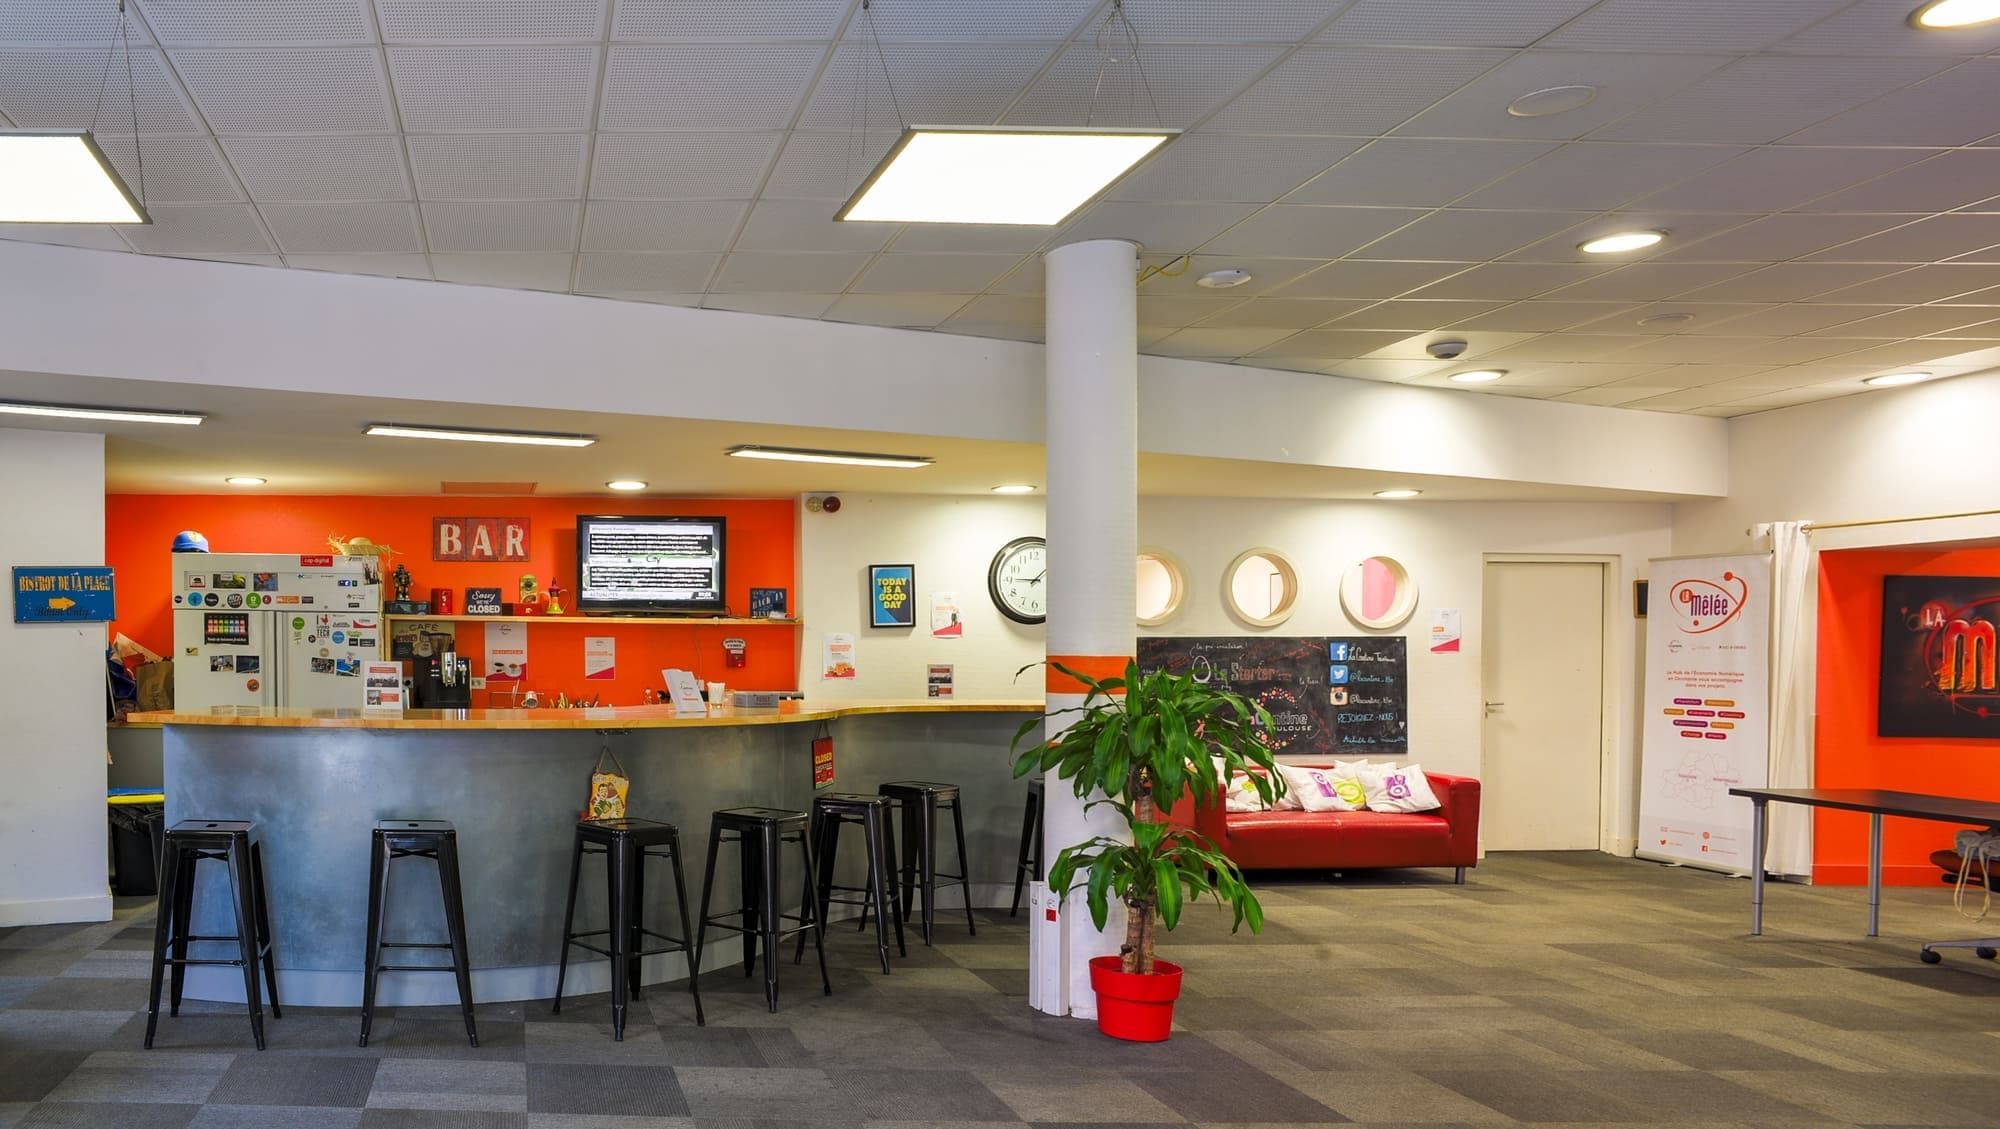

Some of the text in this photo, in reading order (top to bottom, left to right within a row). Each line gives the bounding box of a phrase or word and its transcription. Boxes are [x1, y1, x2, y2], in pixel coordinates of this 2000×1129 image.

[440, 524, 525, 556] BAR
[1020, 555, 1026, 564] 11
[1030, 551, 1039, 560] 12
[1011, 565, 1020, 574] 10
[19, 576, 111, 592] BISTROT DE LA PLAGE
[877, 577, 907, 586] TODAY
[1006, 576, 1012, 584] 9
[472, 590, 495, 602] Sorry
[879, 593, 906, 601] GOOD
[1010, 588, 1016, 597] 8
[884, 601, 902, 609] DAY
[1021, 597, 1026, 606] 7
[1032, 600, 1038, 609] 6
[467, 605, 500, 614] CLOSED
[1926, 609, 1945, 627] LA
